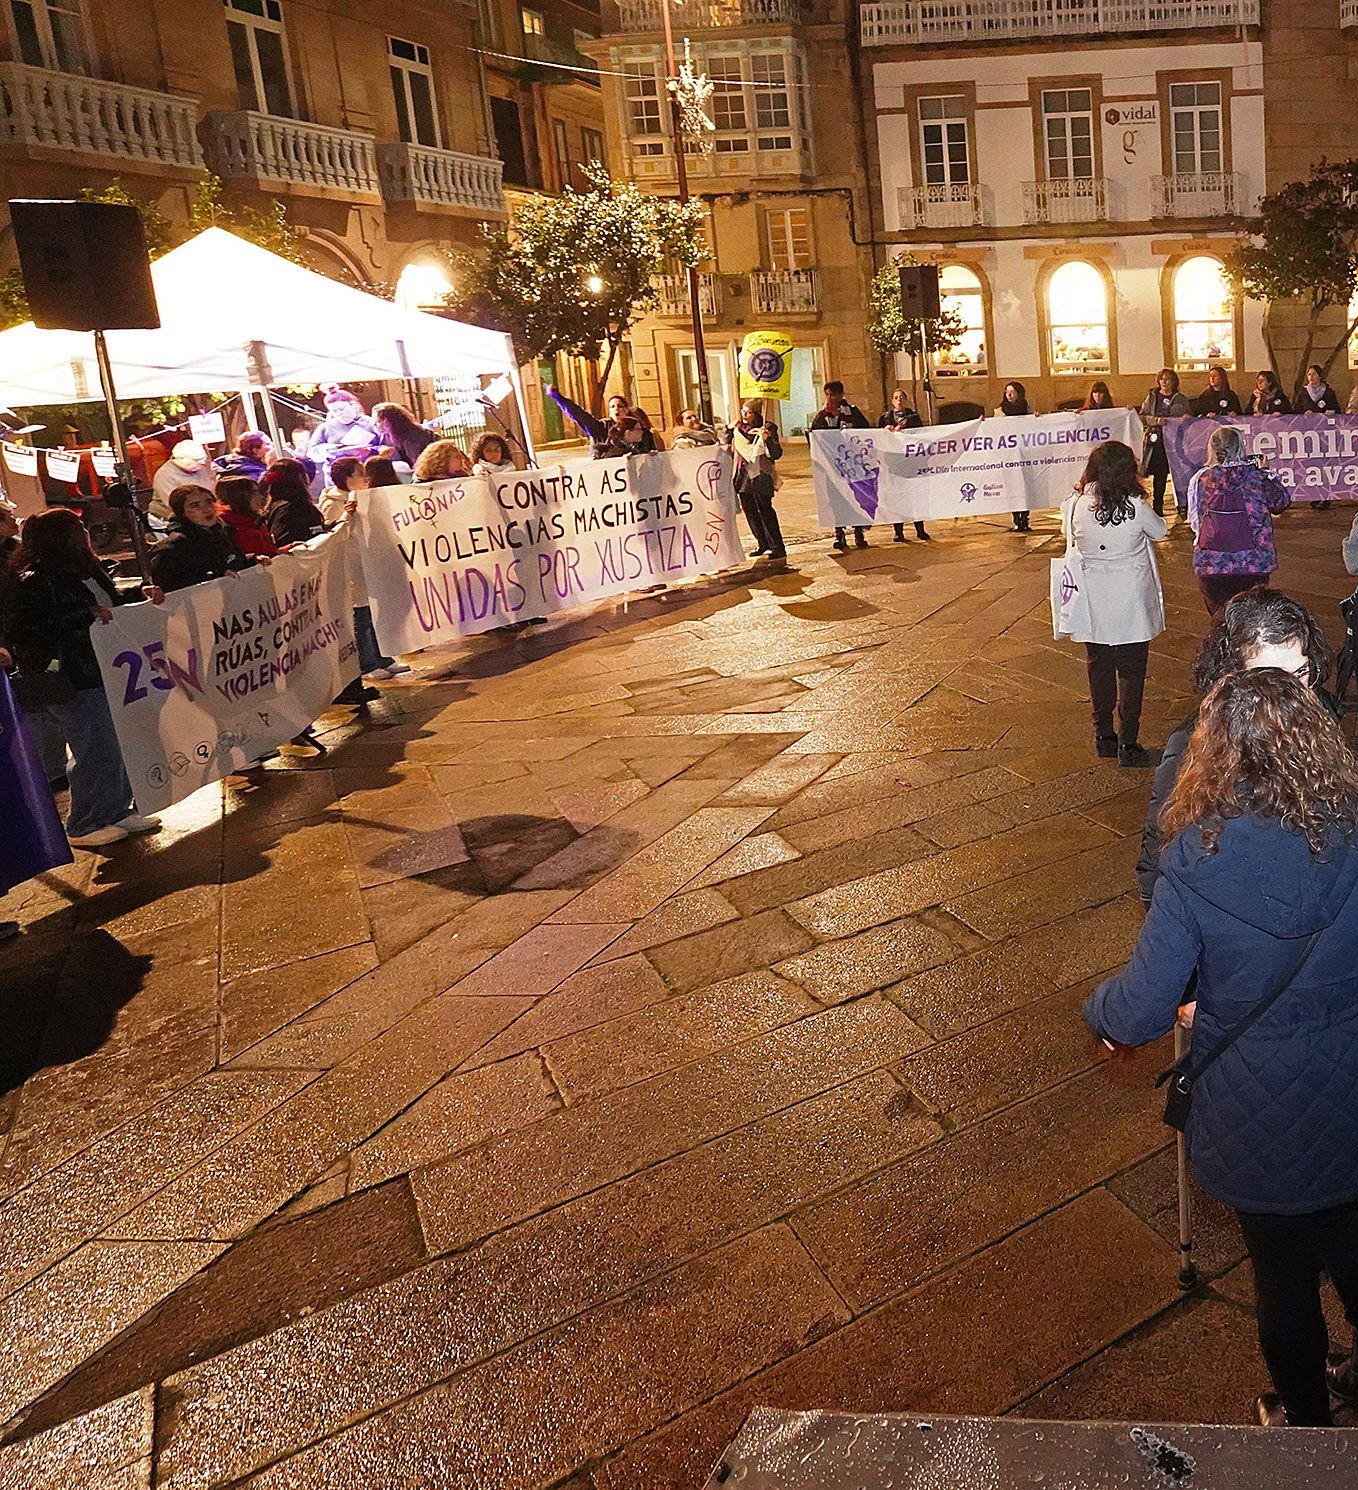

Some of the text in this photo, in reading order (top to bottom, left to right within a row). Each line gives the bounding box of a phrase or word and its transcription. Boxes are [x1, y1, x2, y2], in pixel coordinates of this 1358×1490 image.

[1122, 105, 1156, 120] vidal
[905, 426, 1111, 458] FACER VER AS VIOLENCIAS
[1005, 459, 1031, 468] contra
[1040, 455, 1076, 464] violencia
[497, 468, 627, 509] CONTRA AS
[398, 491, 693, 570] VIOLENCIAS MACHISTAS
[703, 511, 725, 556] 25N
[409, 524, 698, 632] UNIDAS POR XUSTIZA
[212, 609, 254, 645] NAS
[258, 588, 298, 628] AULAS
[112, 641, 207, 706] 25N
[216, 636, 268, 676] RÚAS,
[216, 649, 302, 703] VIOLENCIA
